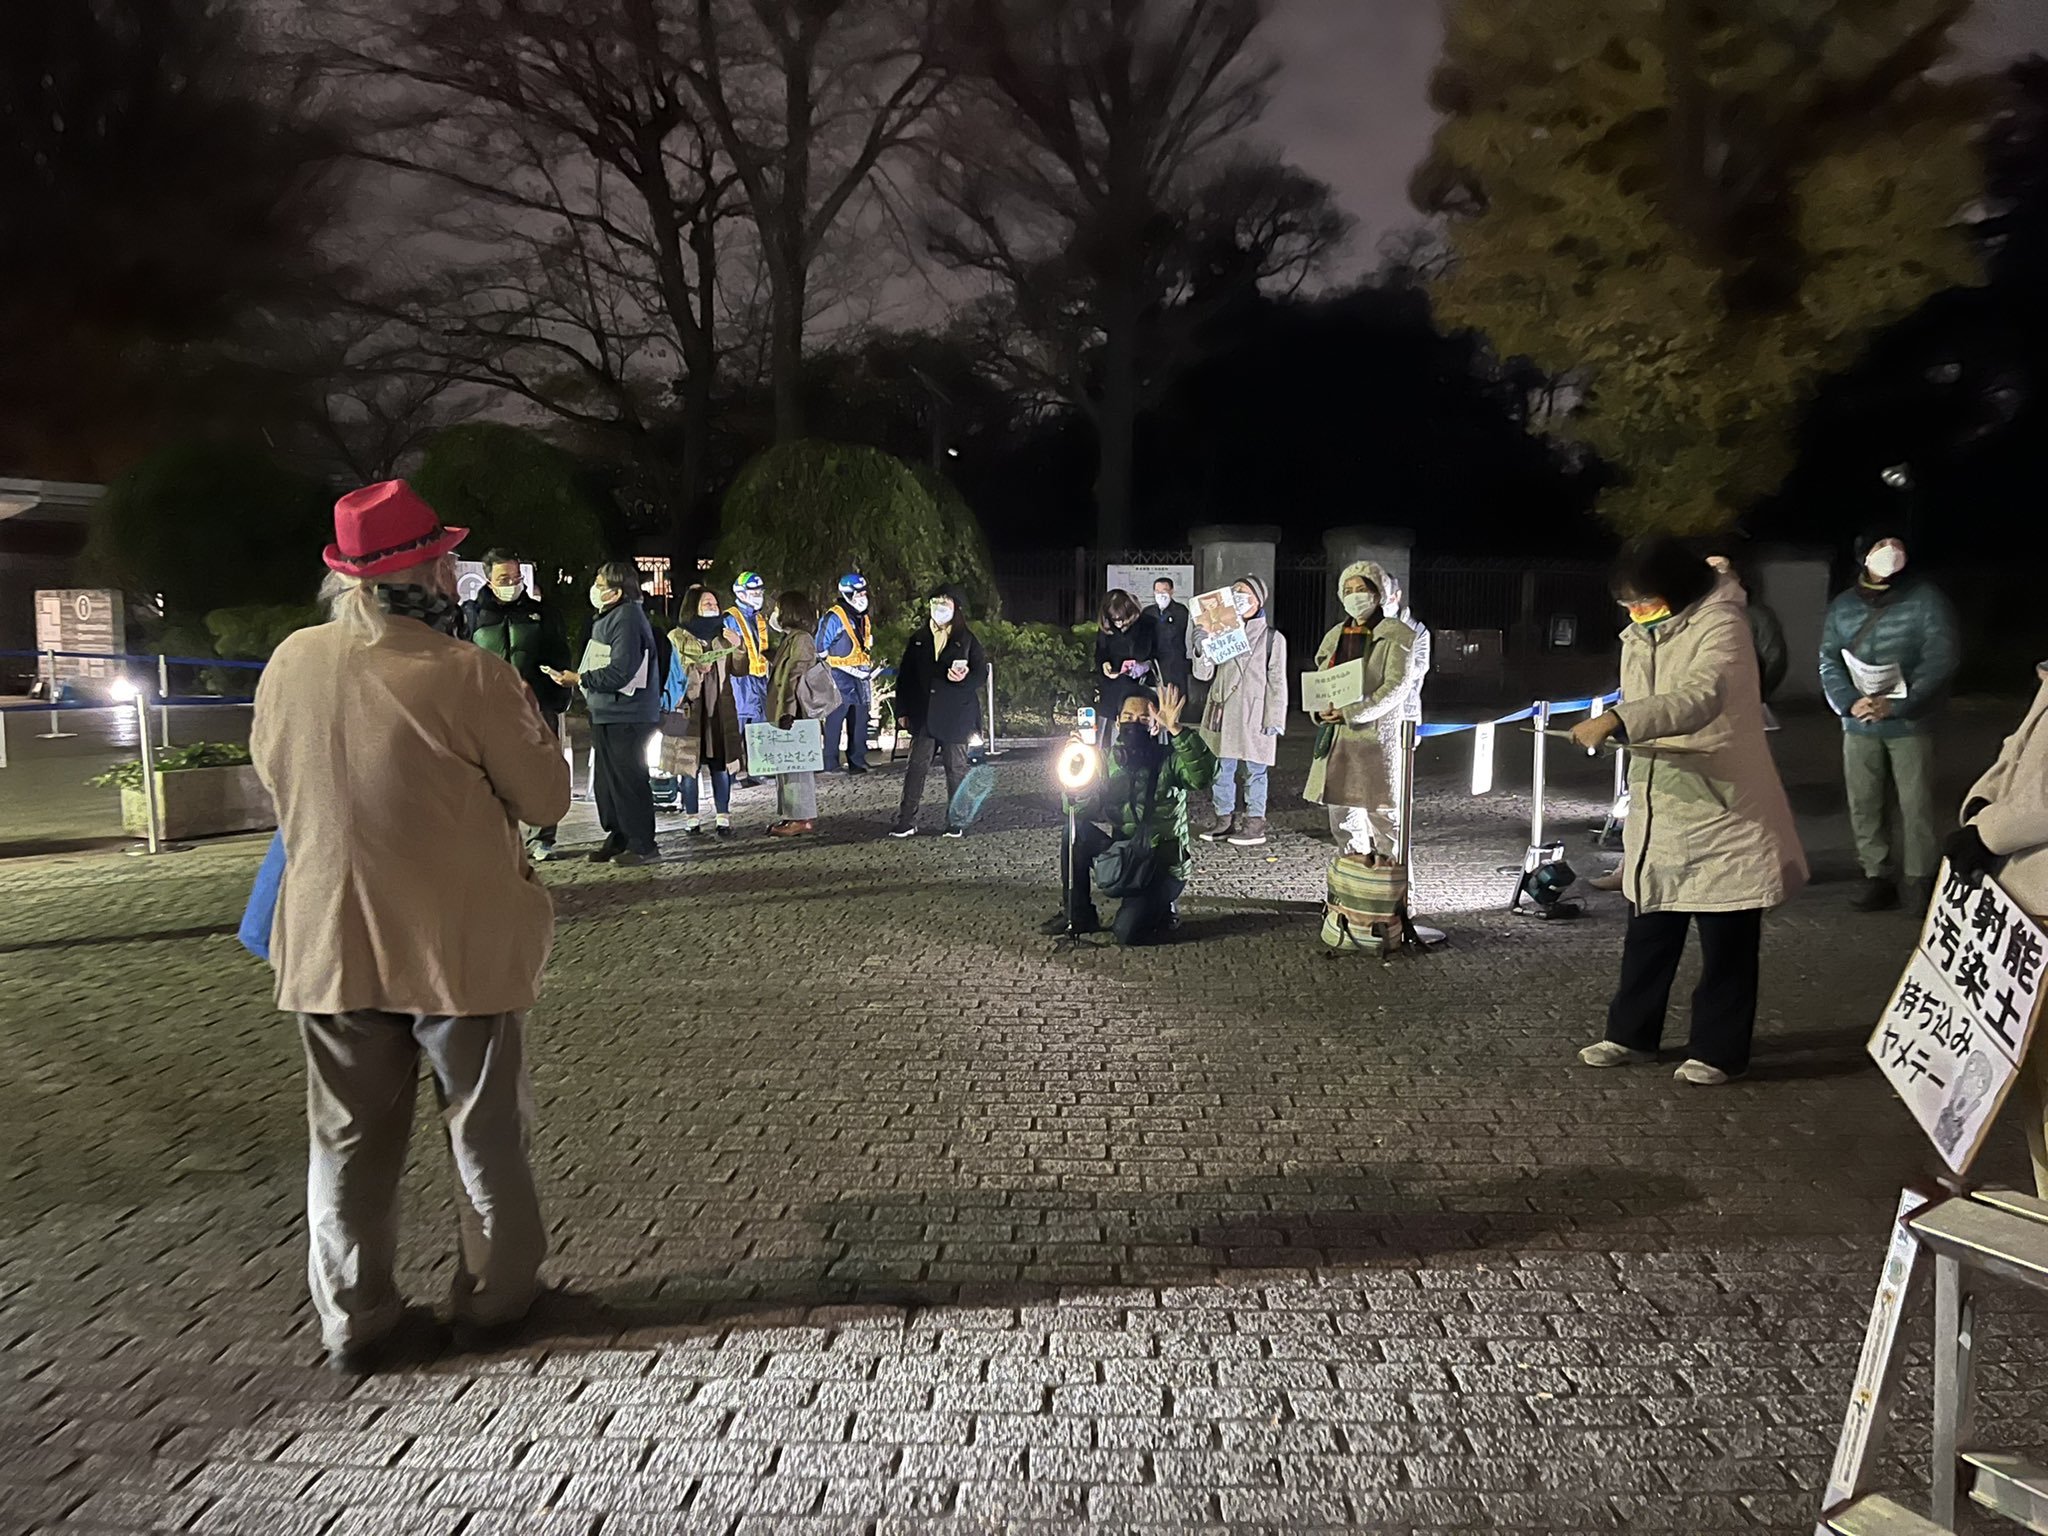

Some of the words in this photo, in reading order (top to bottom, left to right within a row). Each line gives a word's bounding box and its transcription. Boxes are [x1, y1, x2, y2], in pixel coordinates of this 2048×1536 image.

[1927, 905, 2021, 1051] 汚染土
[1942, 870, 2043, 995] 放射能
[1879, 1023, 1946, 1090] ヤメテー
[1894, 976, 1974, 1057] 持ち込み
